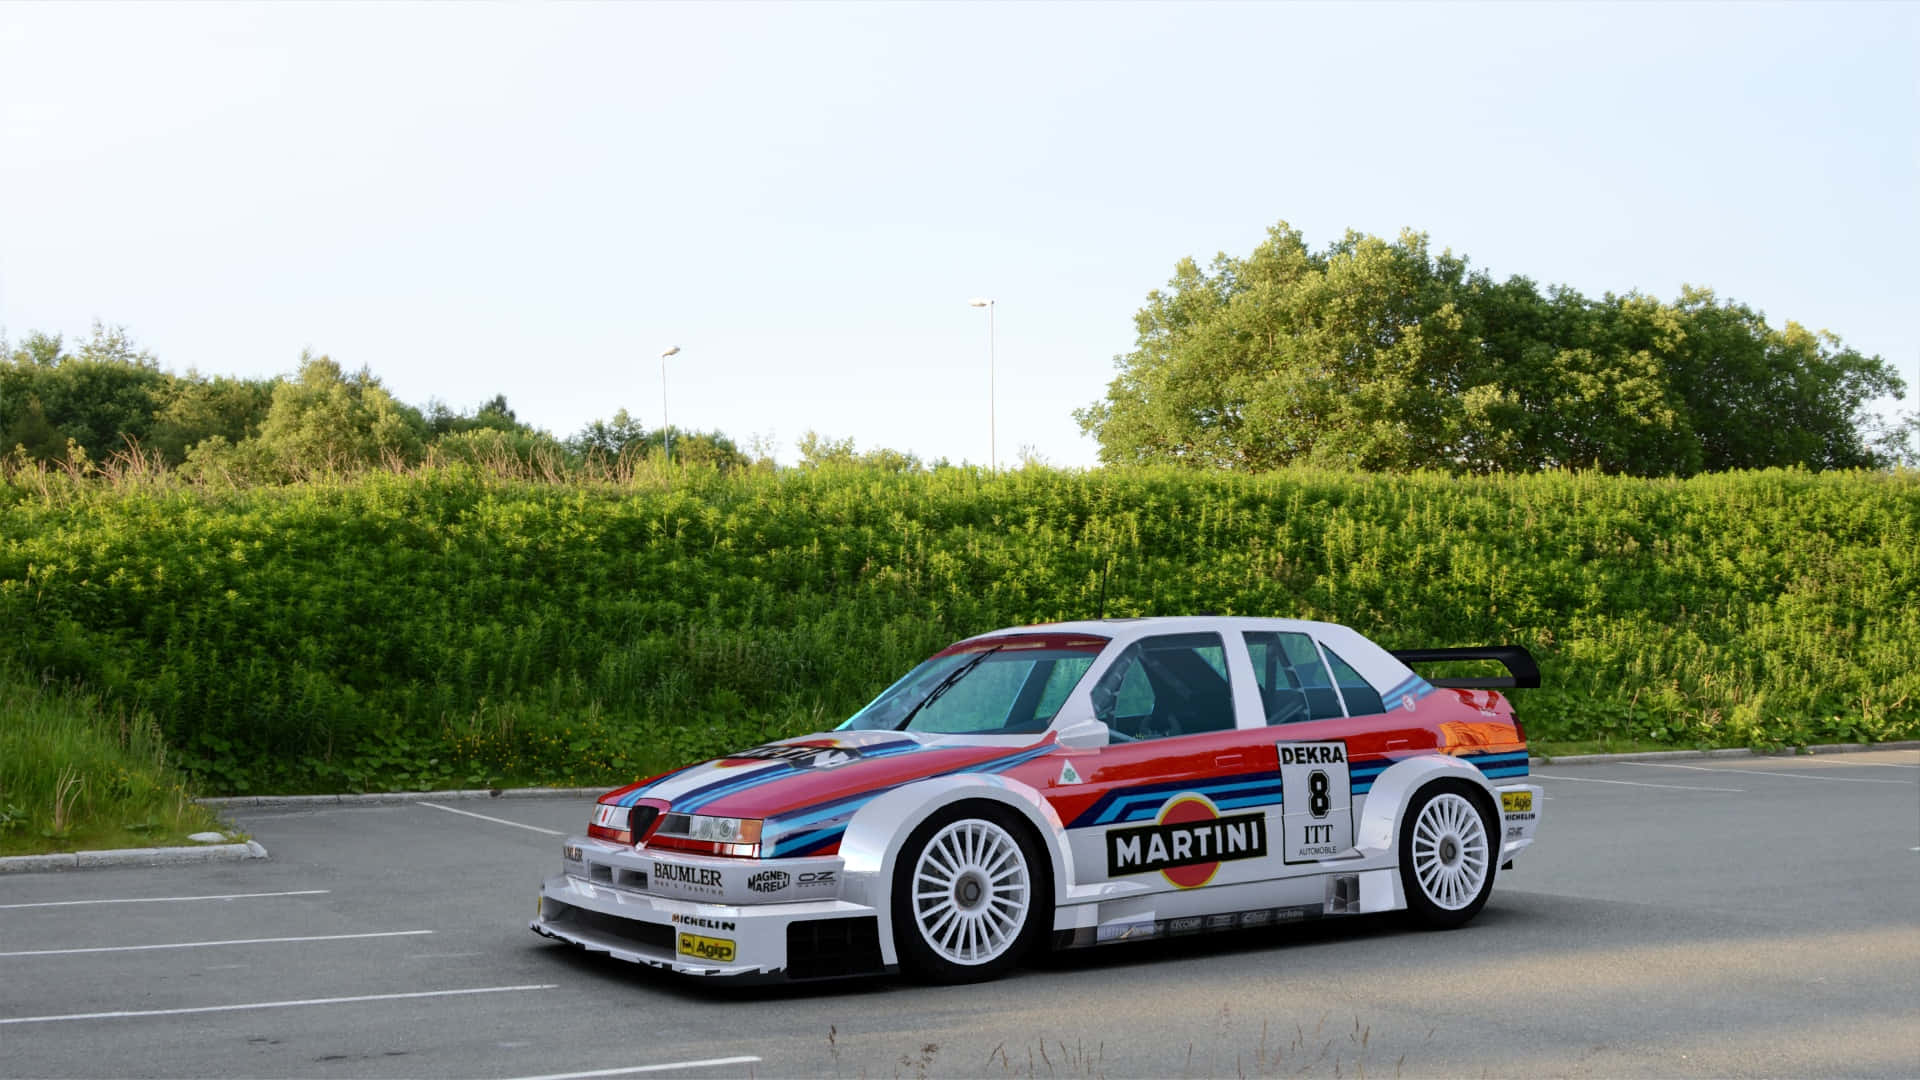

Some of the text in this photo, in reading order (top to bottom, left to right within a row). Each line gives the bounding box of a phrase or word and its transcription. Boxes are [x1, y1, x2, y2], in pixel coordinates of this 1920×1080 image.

[1280, 745, 1345, 765] DEKRA
[1308, 769, 1331, 819] 8
[1115, 821, 1259, 868] MARTINI
[1304, 825, 1333, 845] ITT
[1299, 846, 1337, 857] AUTOMOBILE
[654, 862, 722, 888] BÄUMLER
[798, 870, 836, 882] OZ
[672, 913, 736, 931] MICHELIN
[697, 940, 732, 959] Agip
